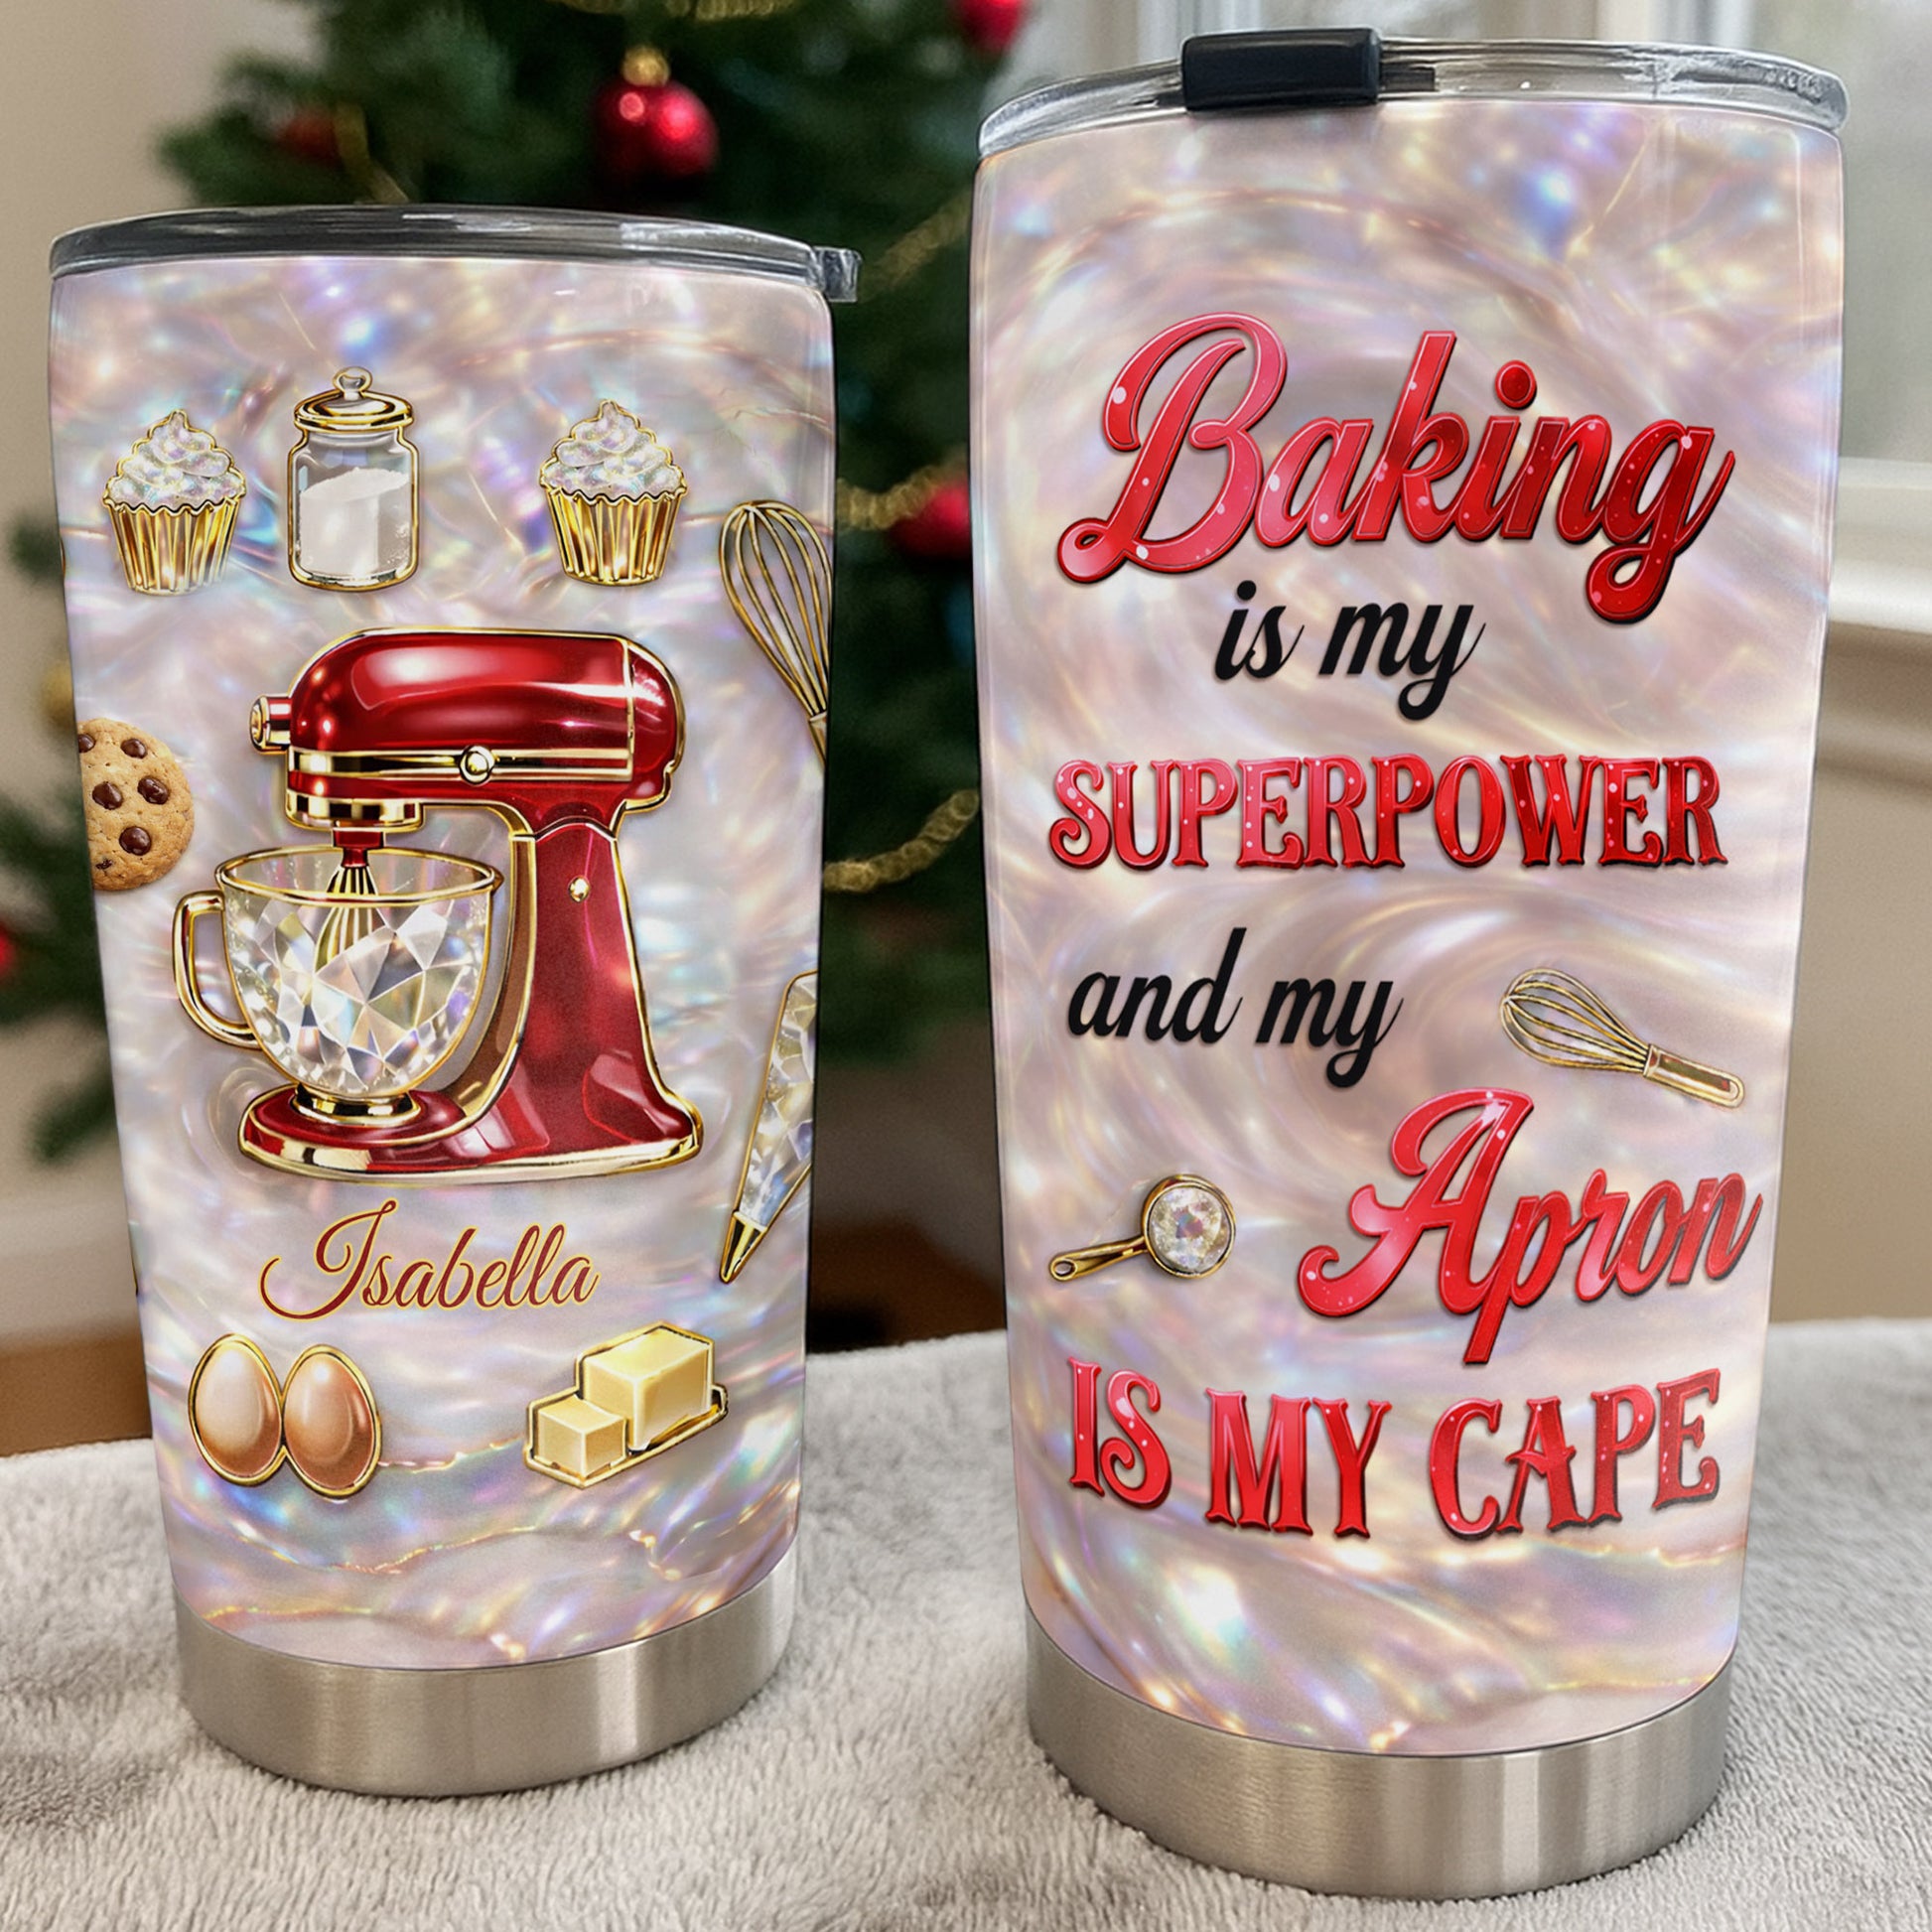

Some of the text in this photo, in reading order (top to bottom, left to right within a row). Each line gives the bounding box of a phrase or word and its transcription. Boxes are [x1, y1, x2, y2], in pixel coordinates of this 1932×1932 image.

[1057, 313, 1735, 622] Baking
[1214, 581, 1486, 720] is my
[1048, 754, 1728, 871] SUPERPOWER
[1067, 927, 1403, 1089] and my
[259, 1199, 600, 1320] Isabella
[1298, 1088, 1763, 1365] Apron
[1067, 1356, 1722, 1542] IS MY CAPE
